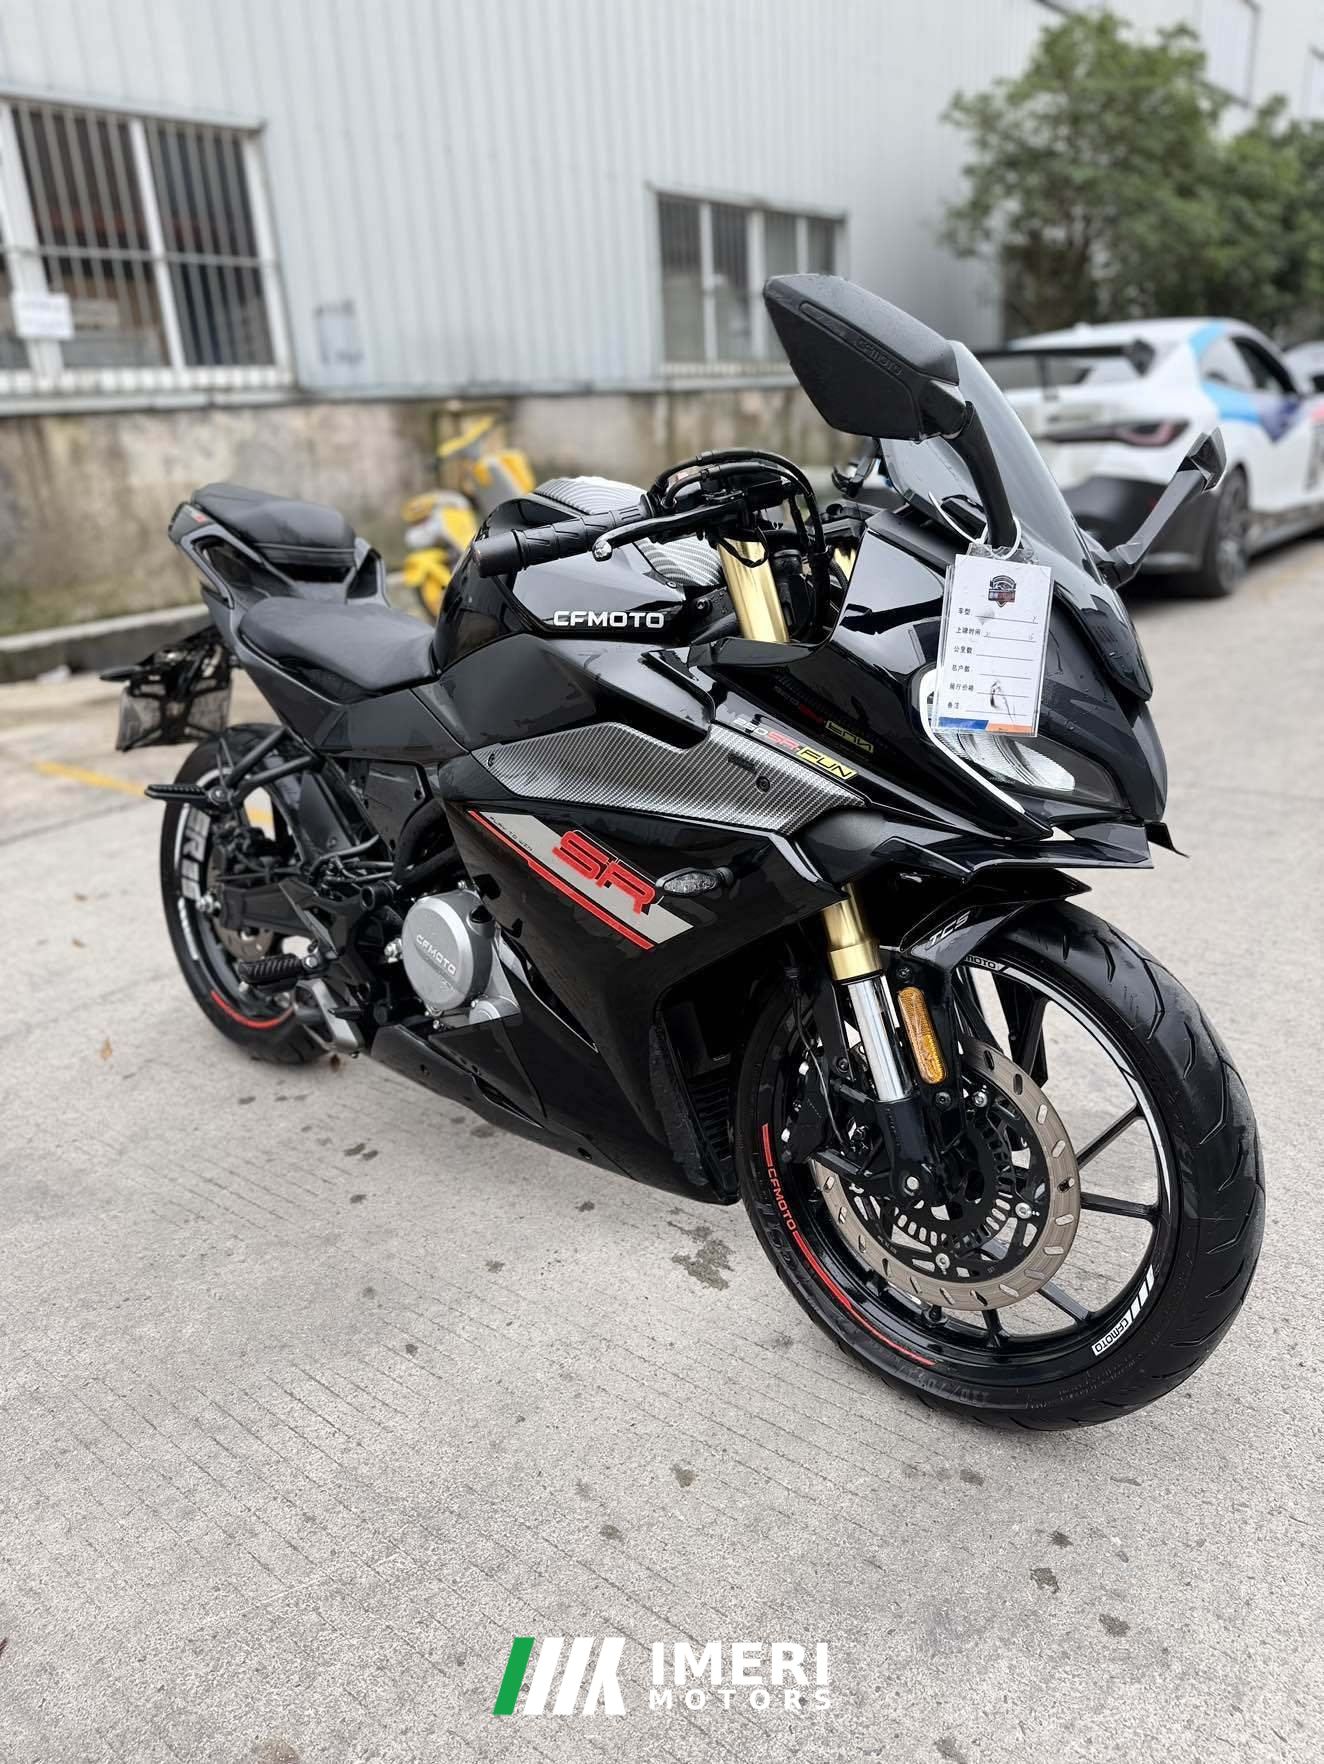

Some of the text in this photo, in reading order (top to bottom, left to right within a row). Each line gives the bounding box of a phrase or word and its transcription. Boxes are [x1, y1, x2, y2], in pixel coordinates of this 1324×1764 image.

[553, 610, 664, 628] CFMOTO
[552, 830, 656, 916] SR
[929, 910, 971, 946] TCS
[416, 934, 457, 976] CFMOTO
[768, 1168, 797, 1231] CFMOTO
[1094, 1317, 1129, 1353] CFMOTO
